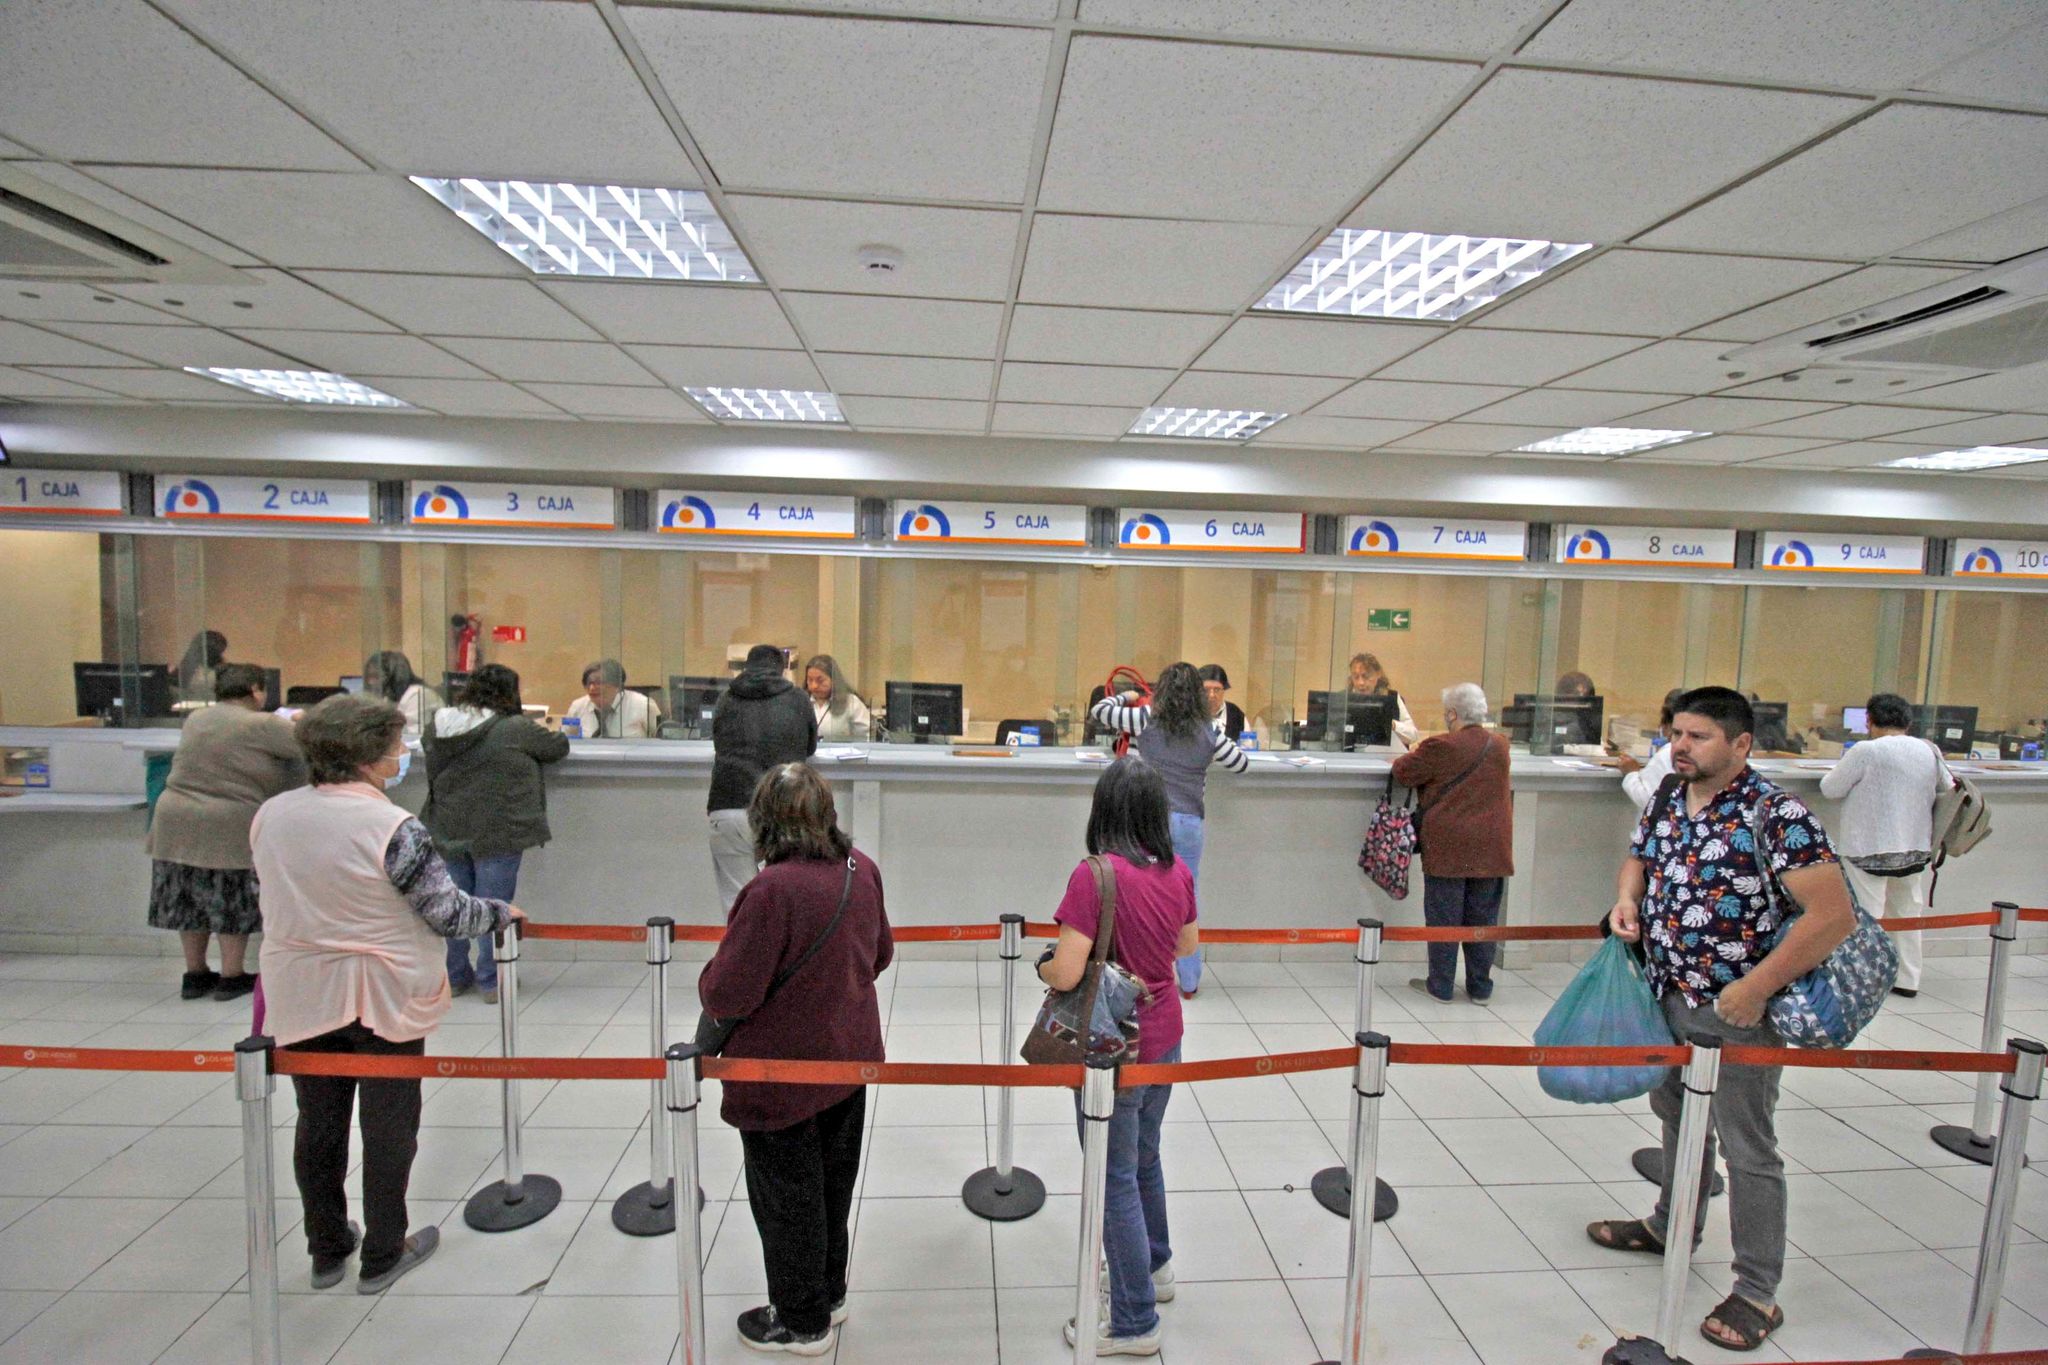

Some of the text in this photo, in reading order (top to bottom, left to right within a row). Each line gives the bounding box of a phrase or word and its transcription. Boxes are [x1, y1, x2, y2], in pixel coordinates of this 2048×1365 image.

[16, 476, 79, 501] 1 CAJA
[264, 484, 328, 509] 2 CAJA
[506, 492, 574, 511] 3 CAJA
[747, 502, 814, 520] 4 CAJA
[984, 511, 1049, 529] 5 CAJA
[1205, 519, 1265, 537] 6 CAJA
[1433, 526, 1486, 544] 7 CAJA
[1649, 536, 1704, 555] 8 CAJA
[1841, 543, 1886, 560] 9 CAJA
[2018, 550, 2039, 568] 10
[458, 1063, 527, 1073] LOS HEROES
